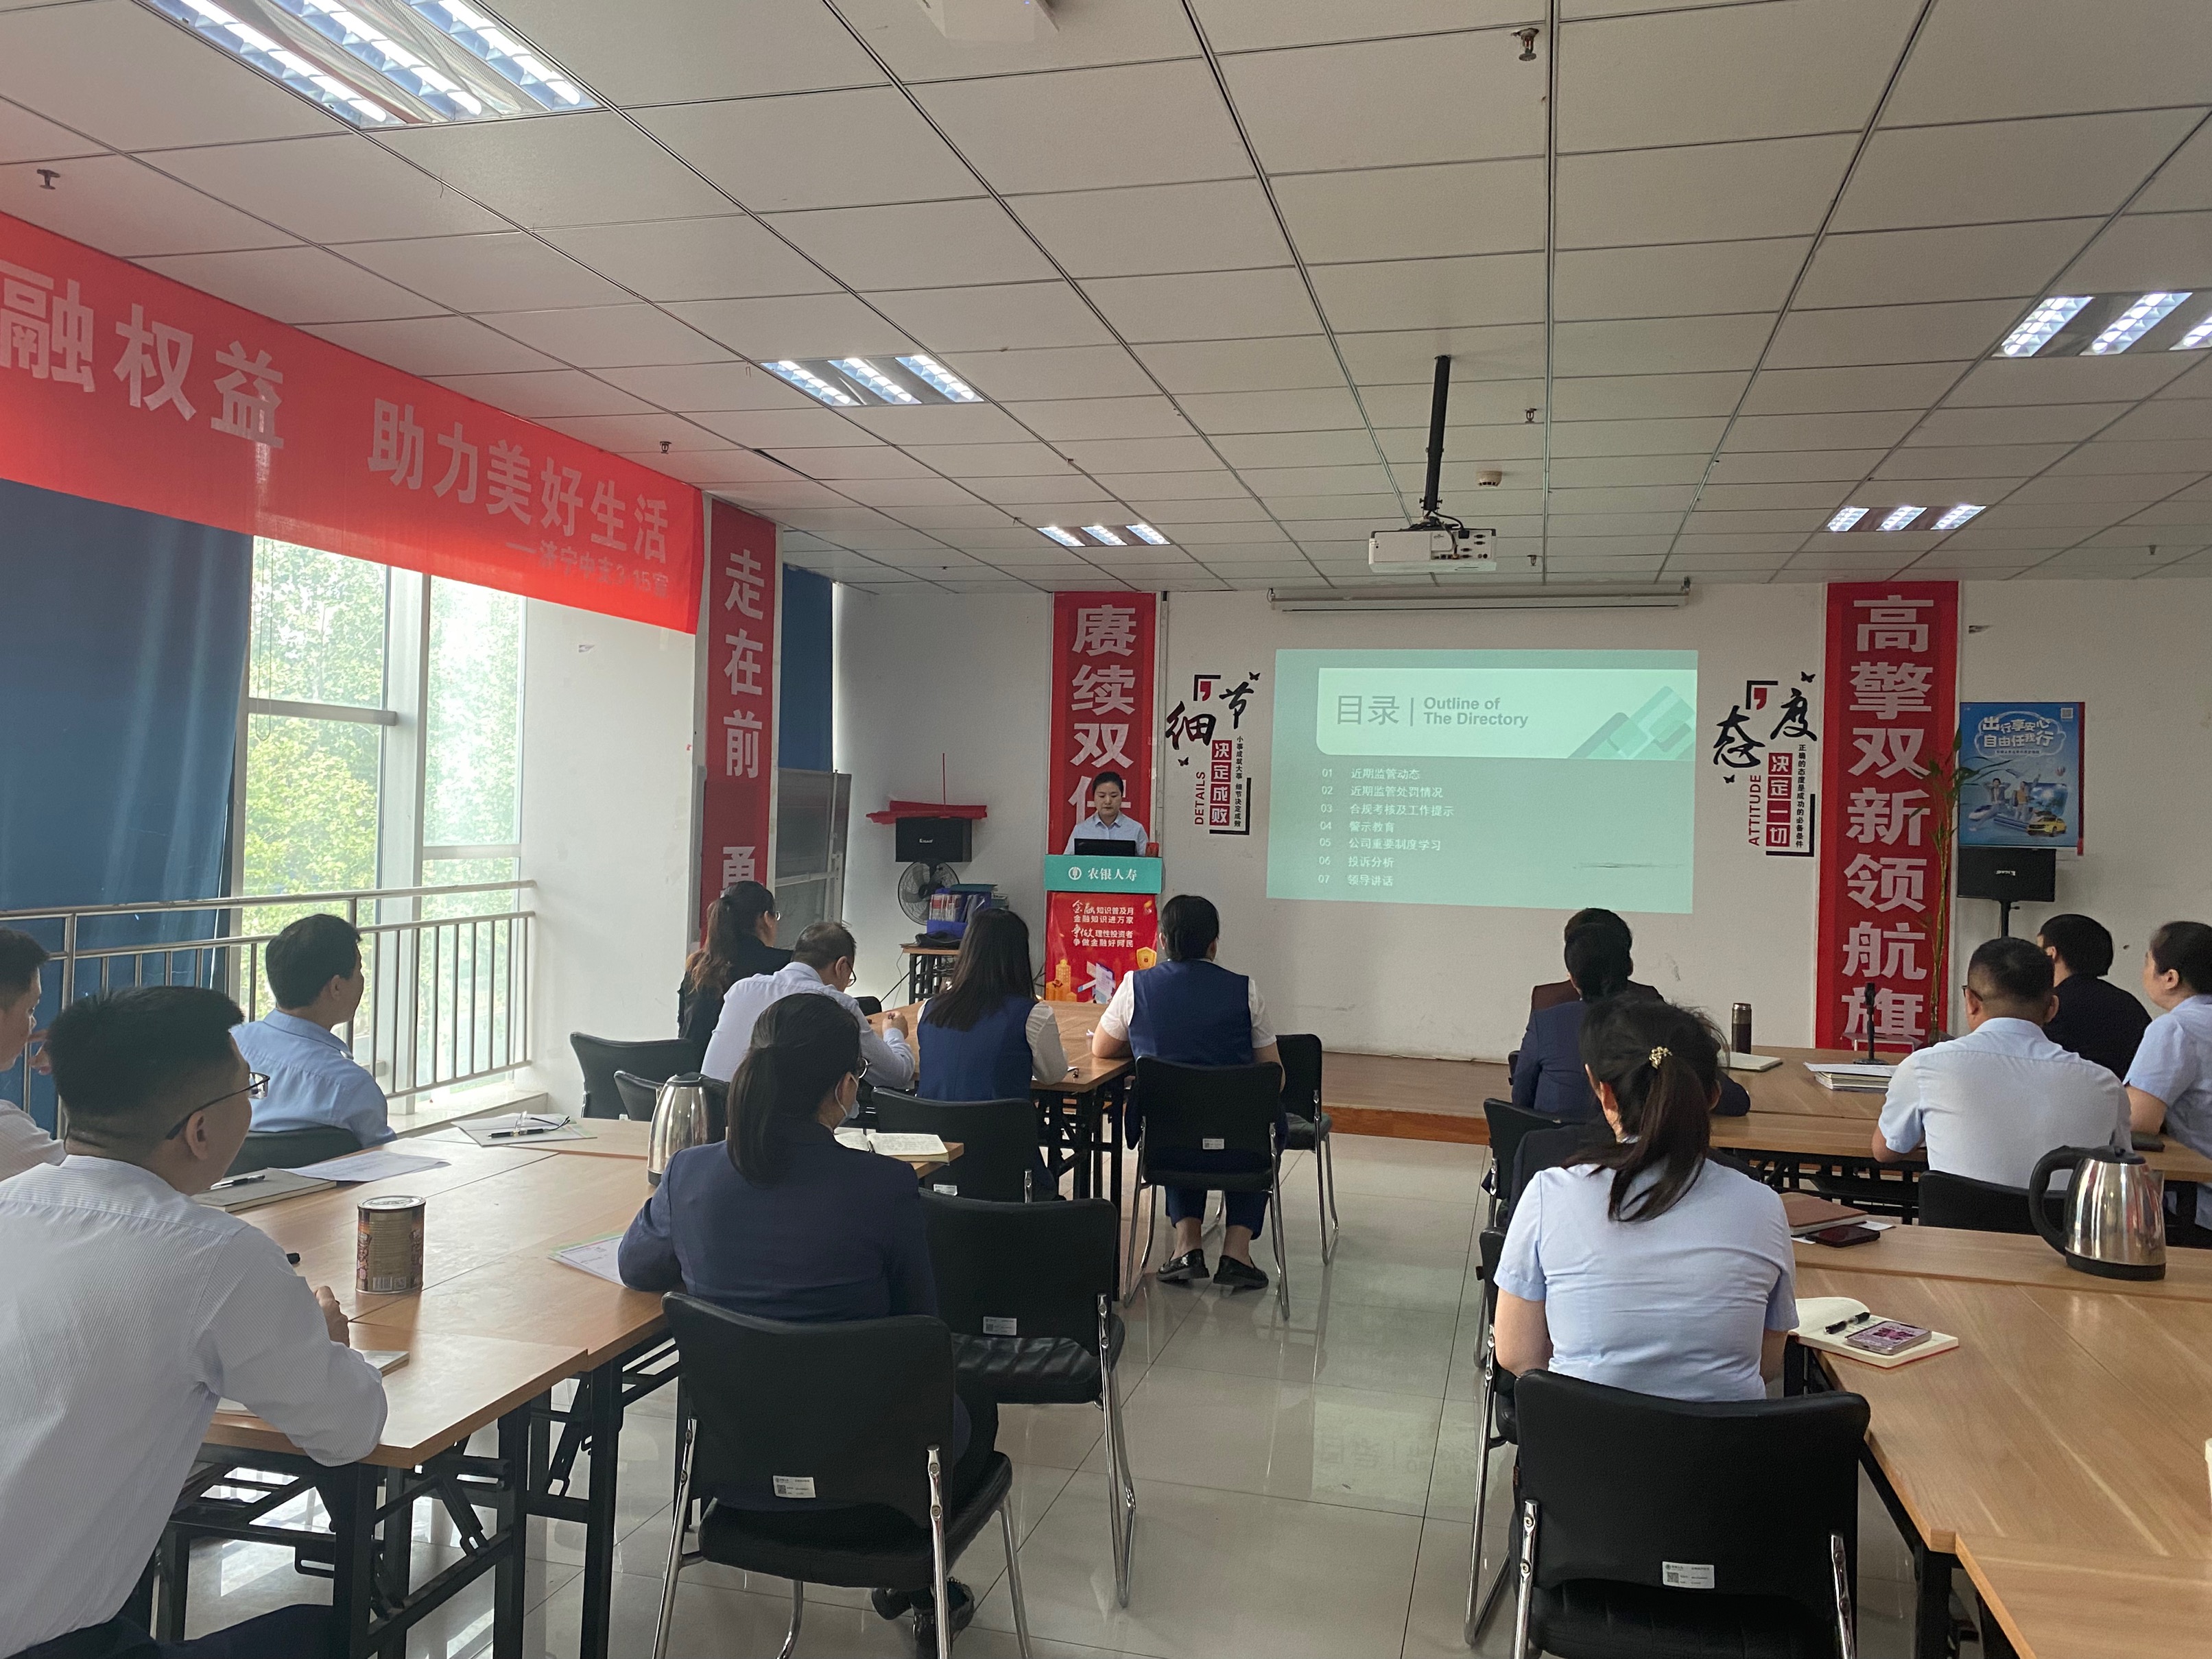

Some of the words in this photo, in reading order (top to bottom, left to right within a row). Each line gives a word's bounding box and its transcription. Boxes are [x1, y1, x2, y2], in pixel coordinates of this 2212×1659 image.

[0, 260, 285, 451] 融权益
[367, 397, 669, 565] 助力美好生活
[723, 549, 765, 779] 走在前
[1337, 695, 1400, 726] 目录
[1423, 697, 1479, 710] Outline
[1484, 697, 1501, 710] of
[1165, 682, 1254, 750] 细节
[1423, 712, 1452, 725] The
[1457, 712, 1528, 728] Directory
[1713, 687, 1818, 769] 态度
[1982, 717, 2052, 734] 出行享安心
[1984, 730, 2054, 748] 自由任我行
[1322, 769, 1333, 777] 01
[1351, 768, 1420, 780] 近期监管动态
[1211, 742, 1230, 824] 决定成败
[1194, 771, 1206, 825] DETAILS
[1322, 786, 1333, 795] 02
[1350, 786, 1443, 798] 近期监管处罚情况
[1769, 754, 1790, 845] 决定一切
[1796, 744, 1807, 848] 正确的态度是成功的必备条件
[1234, 783, 1243, 828] 细节决定成败
[1321, 804, 1333, 813] 03
[1350, 804, 1454, 817] 合规考核及工作提示
[1748, 774, 1761, 846] ATTITUDE
[1841, 594, 1935, 1036] 高擎双新领航旗
[1320, 822, 1332, 830] 04
[1349, 821, 1395, 833] 警示教育
[1320, 838, 1331, 847] 05
[1348, 837, 1441, 850] 公司重要制度学习
[1319, 857, 1331, 865] 06
[1348, 857, 1394, 868] 投诉分析
[1087, 868, 1137, 881] 农银人寿
[1318, 875, 1330, 883] 07
[1347, 874, 1394, 886] 领导讲话
[1072, 900, 1134, 915] 金融知识普及月
[1073, 915, 1134, 924] 金融知识进万家
